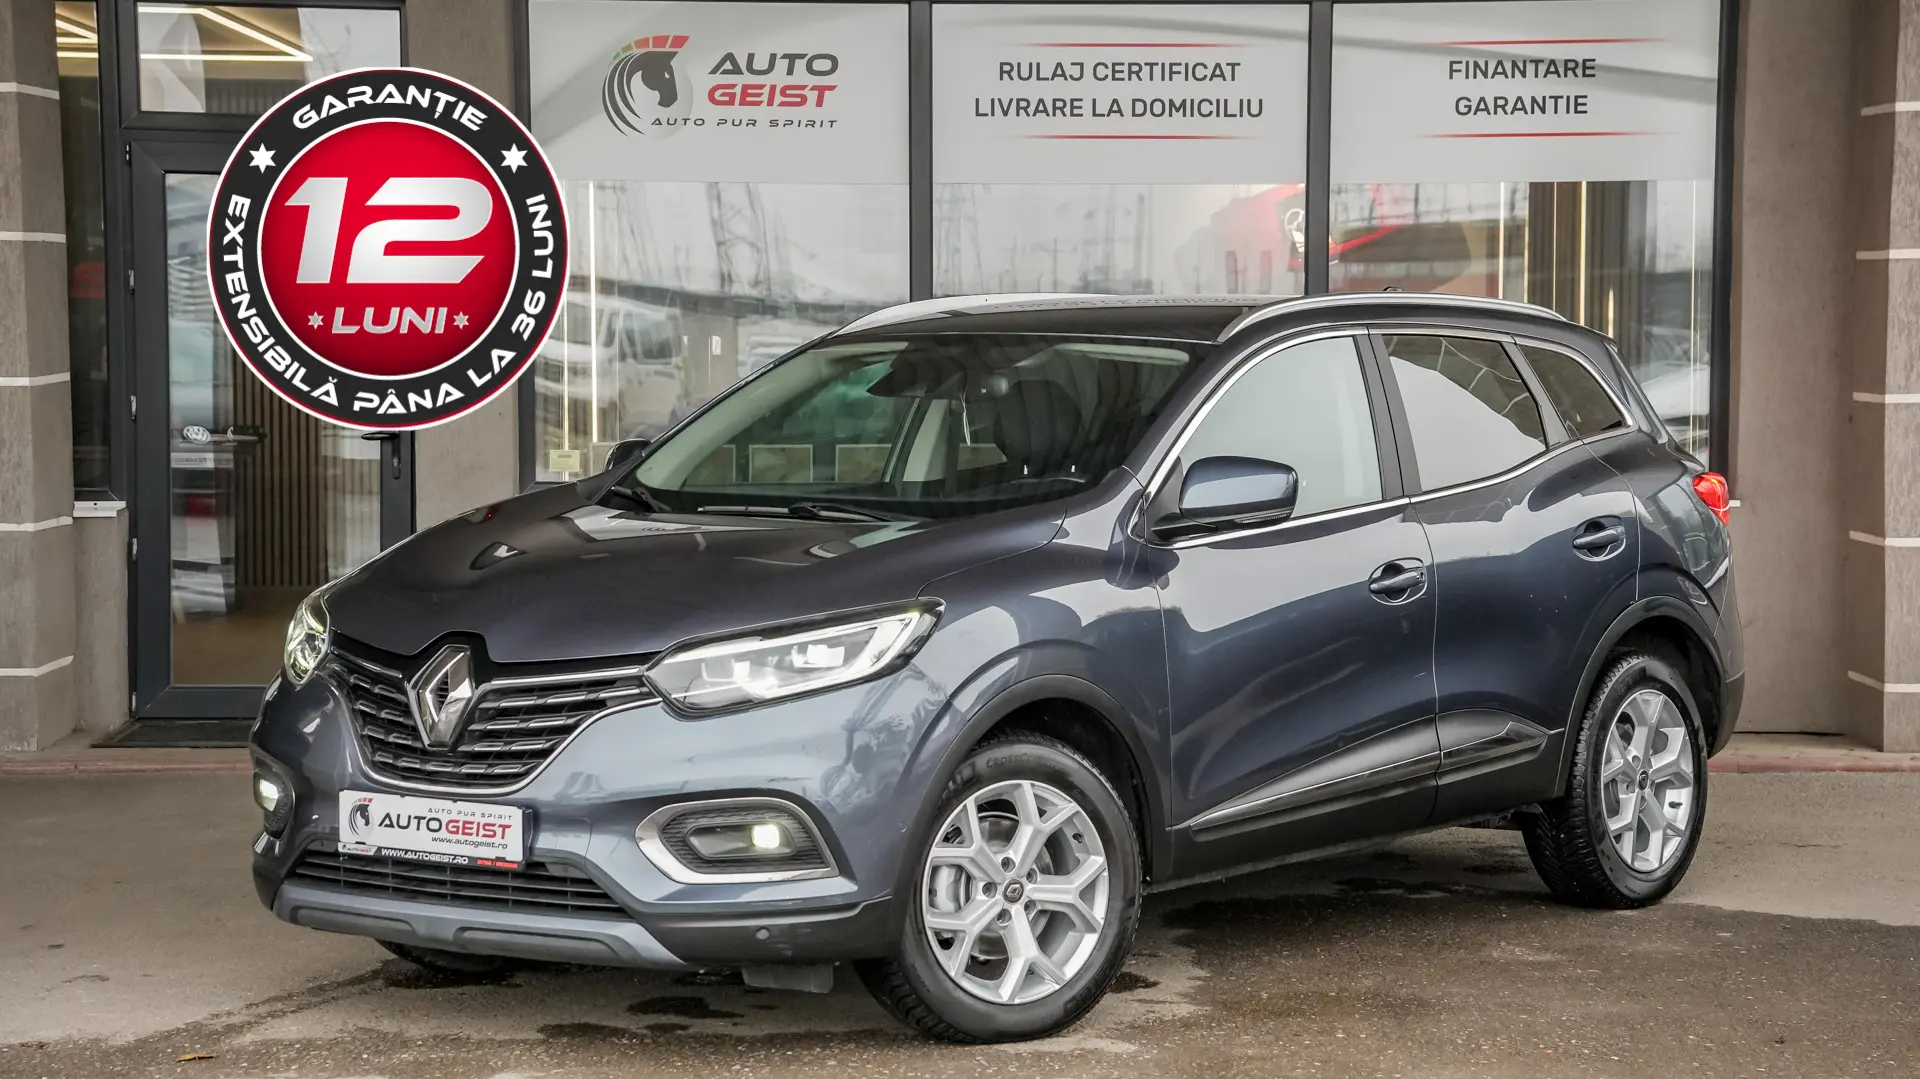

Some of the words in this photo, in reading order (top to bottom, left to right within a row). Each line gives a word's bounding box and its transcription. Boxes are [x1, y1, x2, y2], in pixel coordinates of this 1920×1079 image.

[707, 52, 840, 77] AUTO
[999, 61, 1085, 82] RULAJ
[1092, 61, 1242, 82] CERTIFICAT
[1448, 58, 1597, 80] FINANTARE
[707, 83, 839, 108] GEIST
[1454, 94, 1589, 116] GARANTIE
[974, 97, 1084, 117] LIVRARE
[1091, 97, 1125, 118] LA
[1131, 97, 1264, 118] DOMICILIU
[650, 117, 706, 127] AUTO
[716, 118, 758, 128] PUR
[768, 118, 839, 129] SPIRIT
[427, 807, 453, 816] AUTO
[456, 809, 476, 817] PUR
[480, 812, 513, 821] SPIRIT
[431, 835, 508, 850] www.autogeist.ro
[381, 848, 469, 865] WWW.AUTOGEIST.RO
